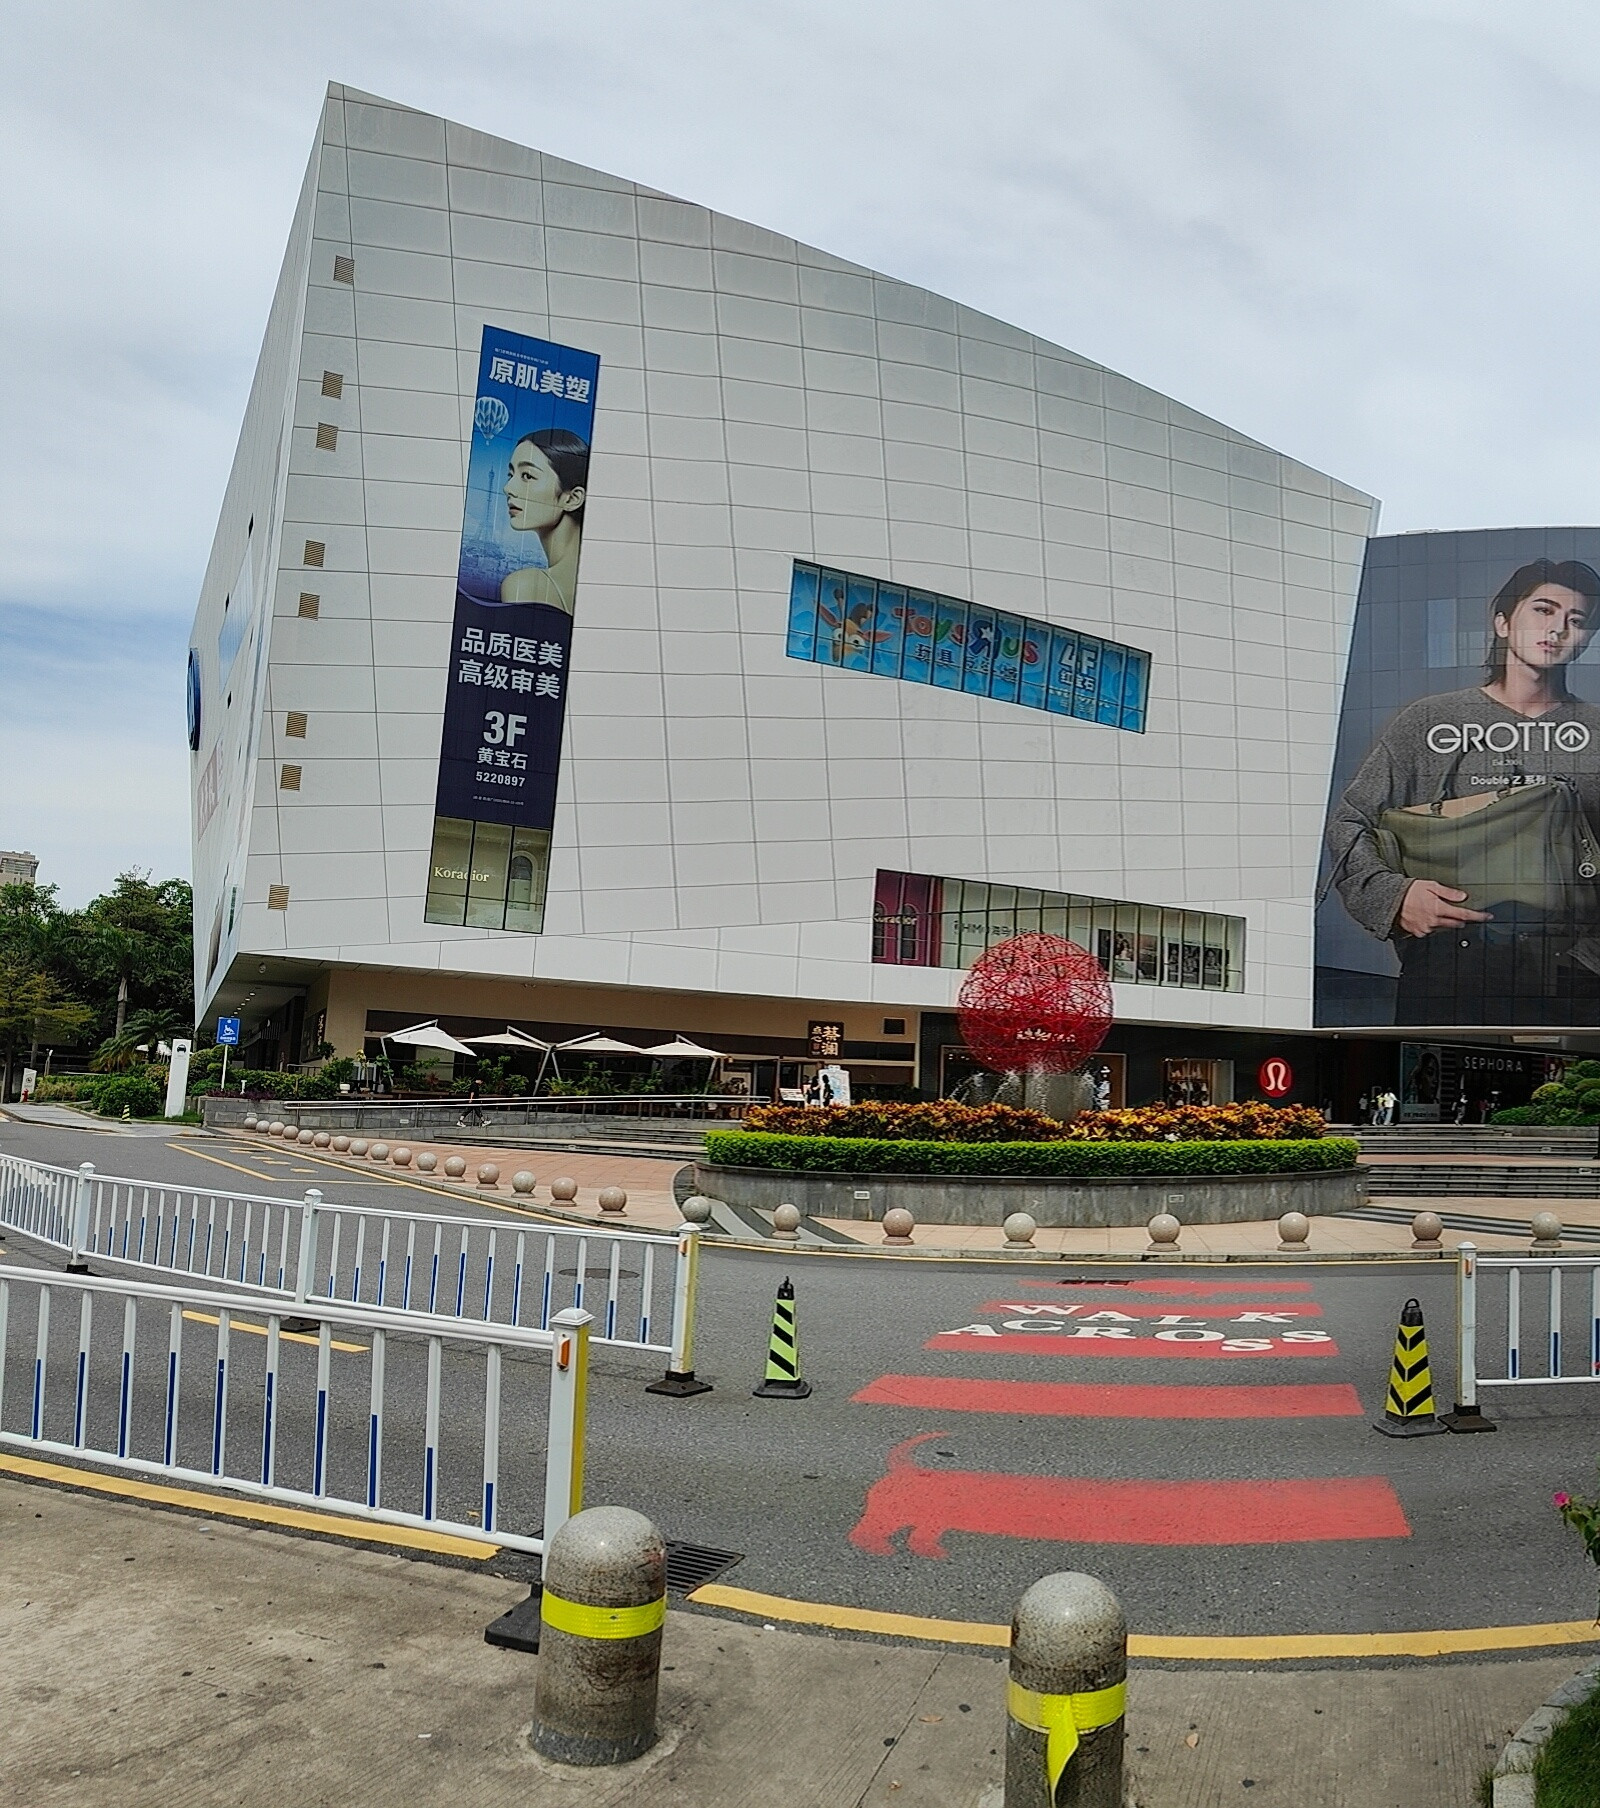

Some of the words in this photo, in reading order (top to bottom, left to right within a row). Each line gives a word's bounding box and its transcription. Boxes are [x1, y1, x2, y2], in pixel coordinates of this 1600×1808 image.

[489, 356, 591, 404] 原肌美塑
[460, 626, 563, 669] 品质医美
[1060, 643, 1098, 676] 4F
[457, 658, 561, 700] 高级审美
[482, 710, 528, 747] 3F
[1426, 721, 1591, 754] GROTTO
[476, 747, 529, 771] 黄宝石
[475, 771, 526, 788] 5220897
[1470, 775, 1510, 786] Double
[1512, 775, 1523, 785] Z
[1464, 1056, 1524, 1072] SEPHORA
[1000, 1304, 1300, 1326] WALK
[938, 1319, 1333, 1352] ACROSS
